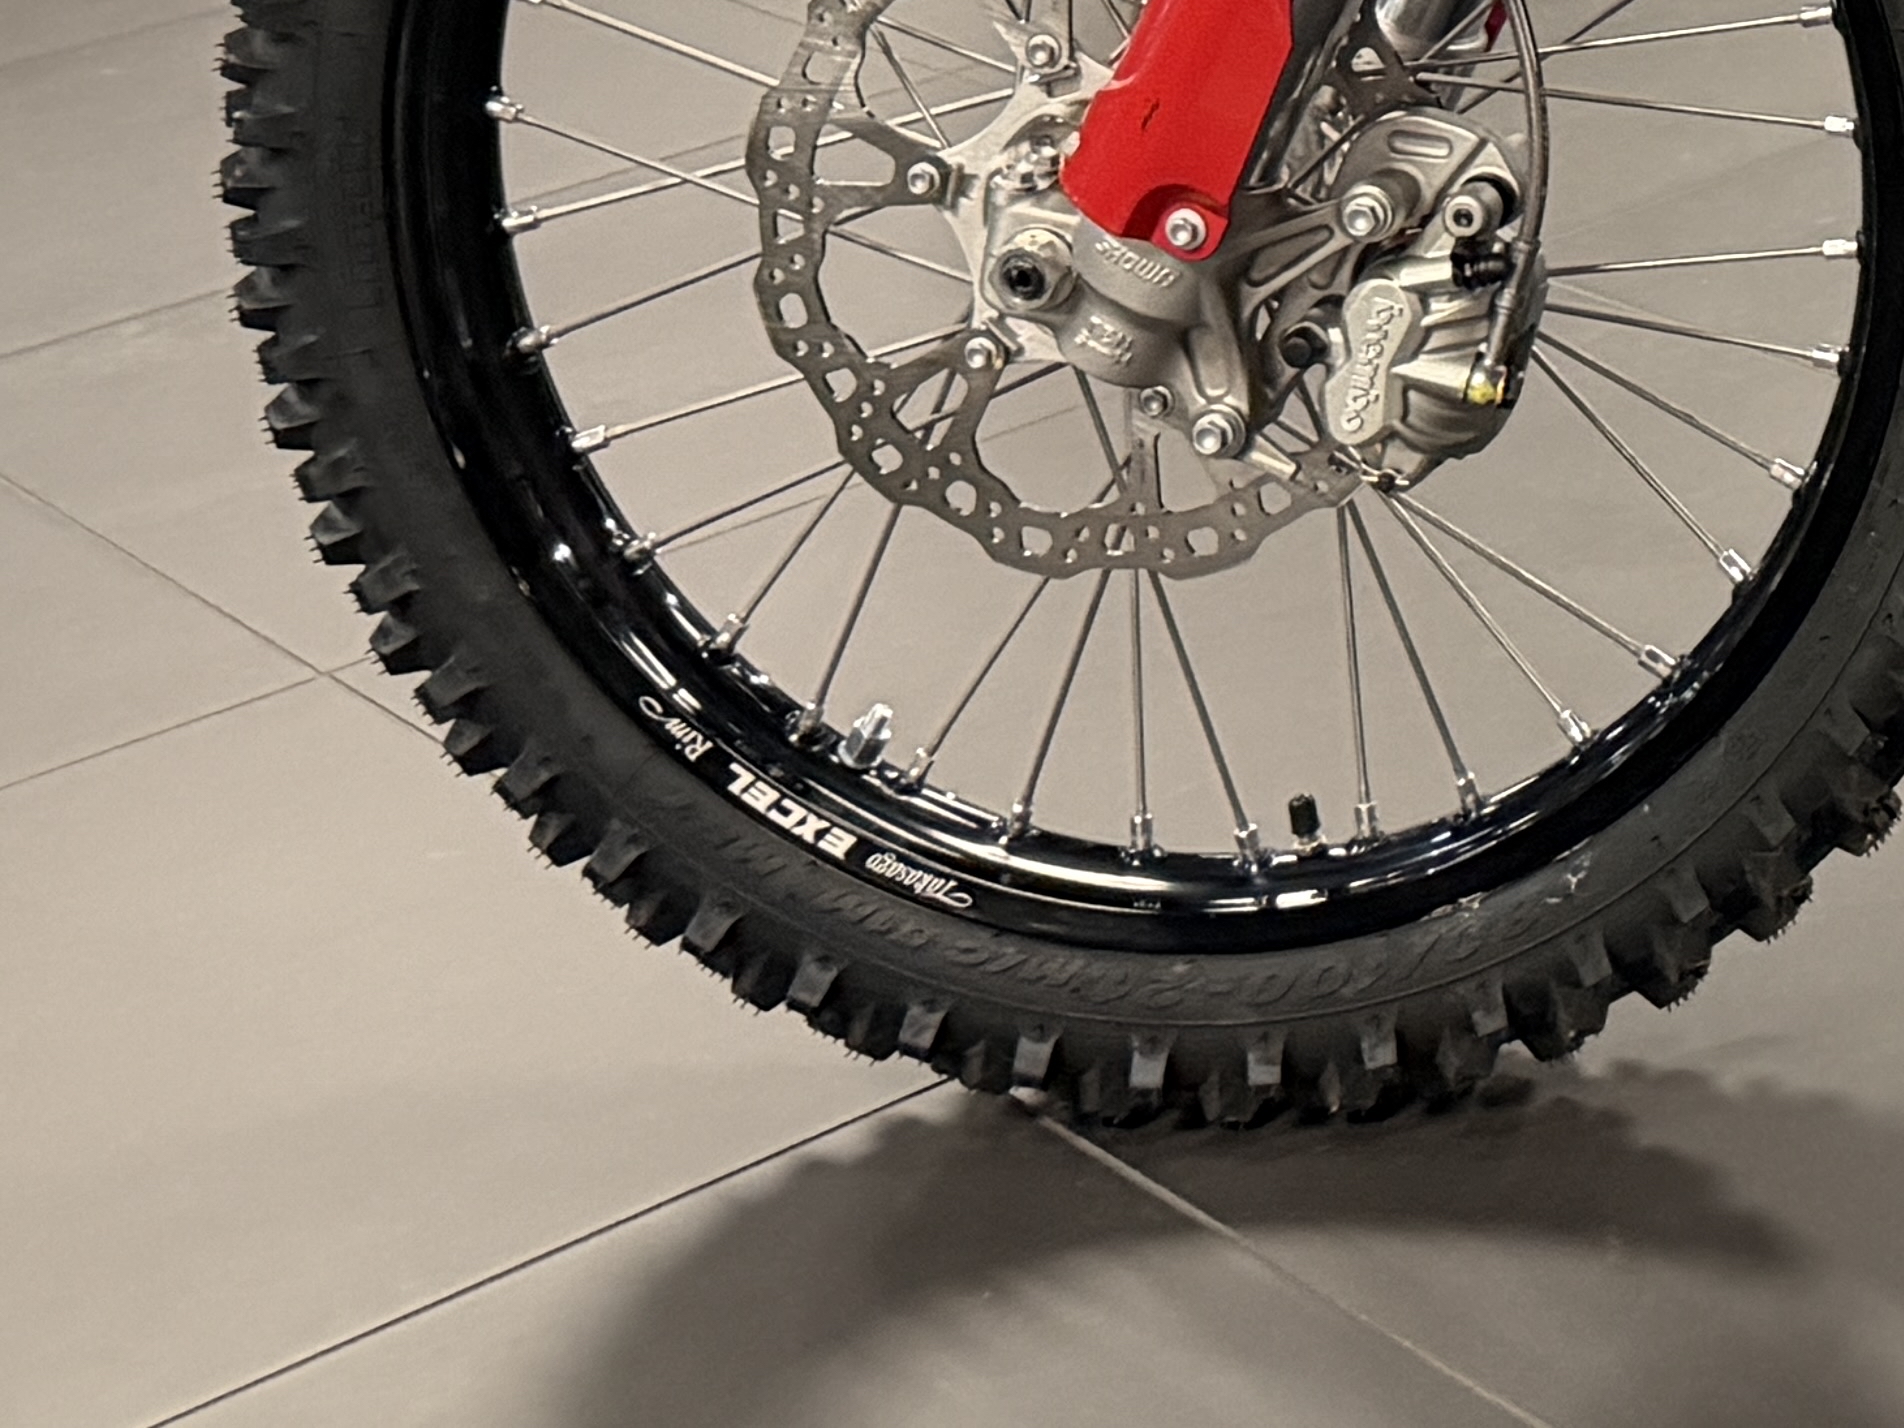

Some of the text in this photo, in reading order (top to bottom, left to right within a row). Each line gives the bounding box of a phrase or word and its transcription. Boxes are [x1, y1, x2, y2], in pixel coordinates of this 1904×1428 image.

[1095, 240, 1181, 289] SHOWA
[1343, 295, 1404, 434] brembo
[639, 695, 711, 766] Rim
[725, 762, 859, 861] EXCEL
[865, 852, 975, 910] Takasago
